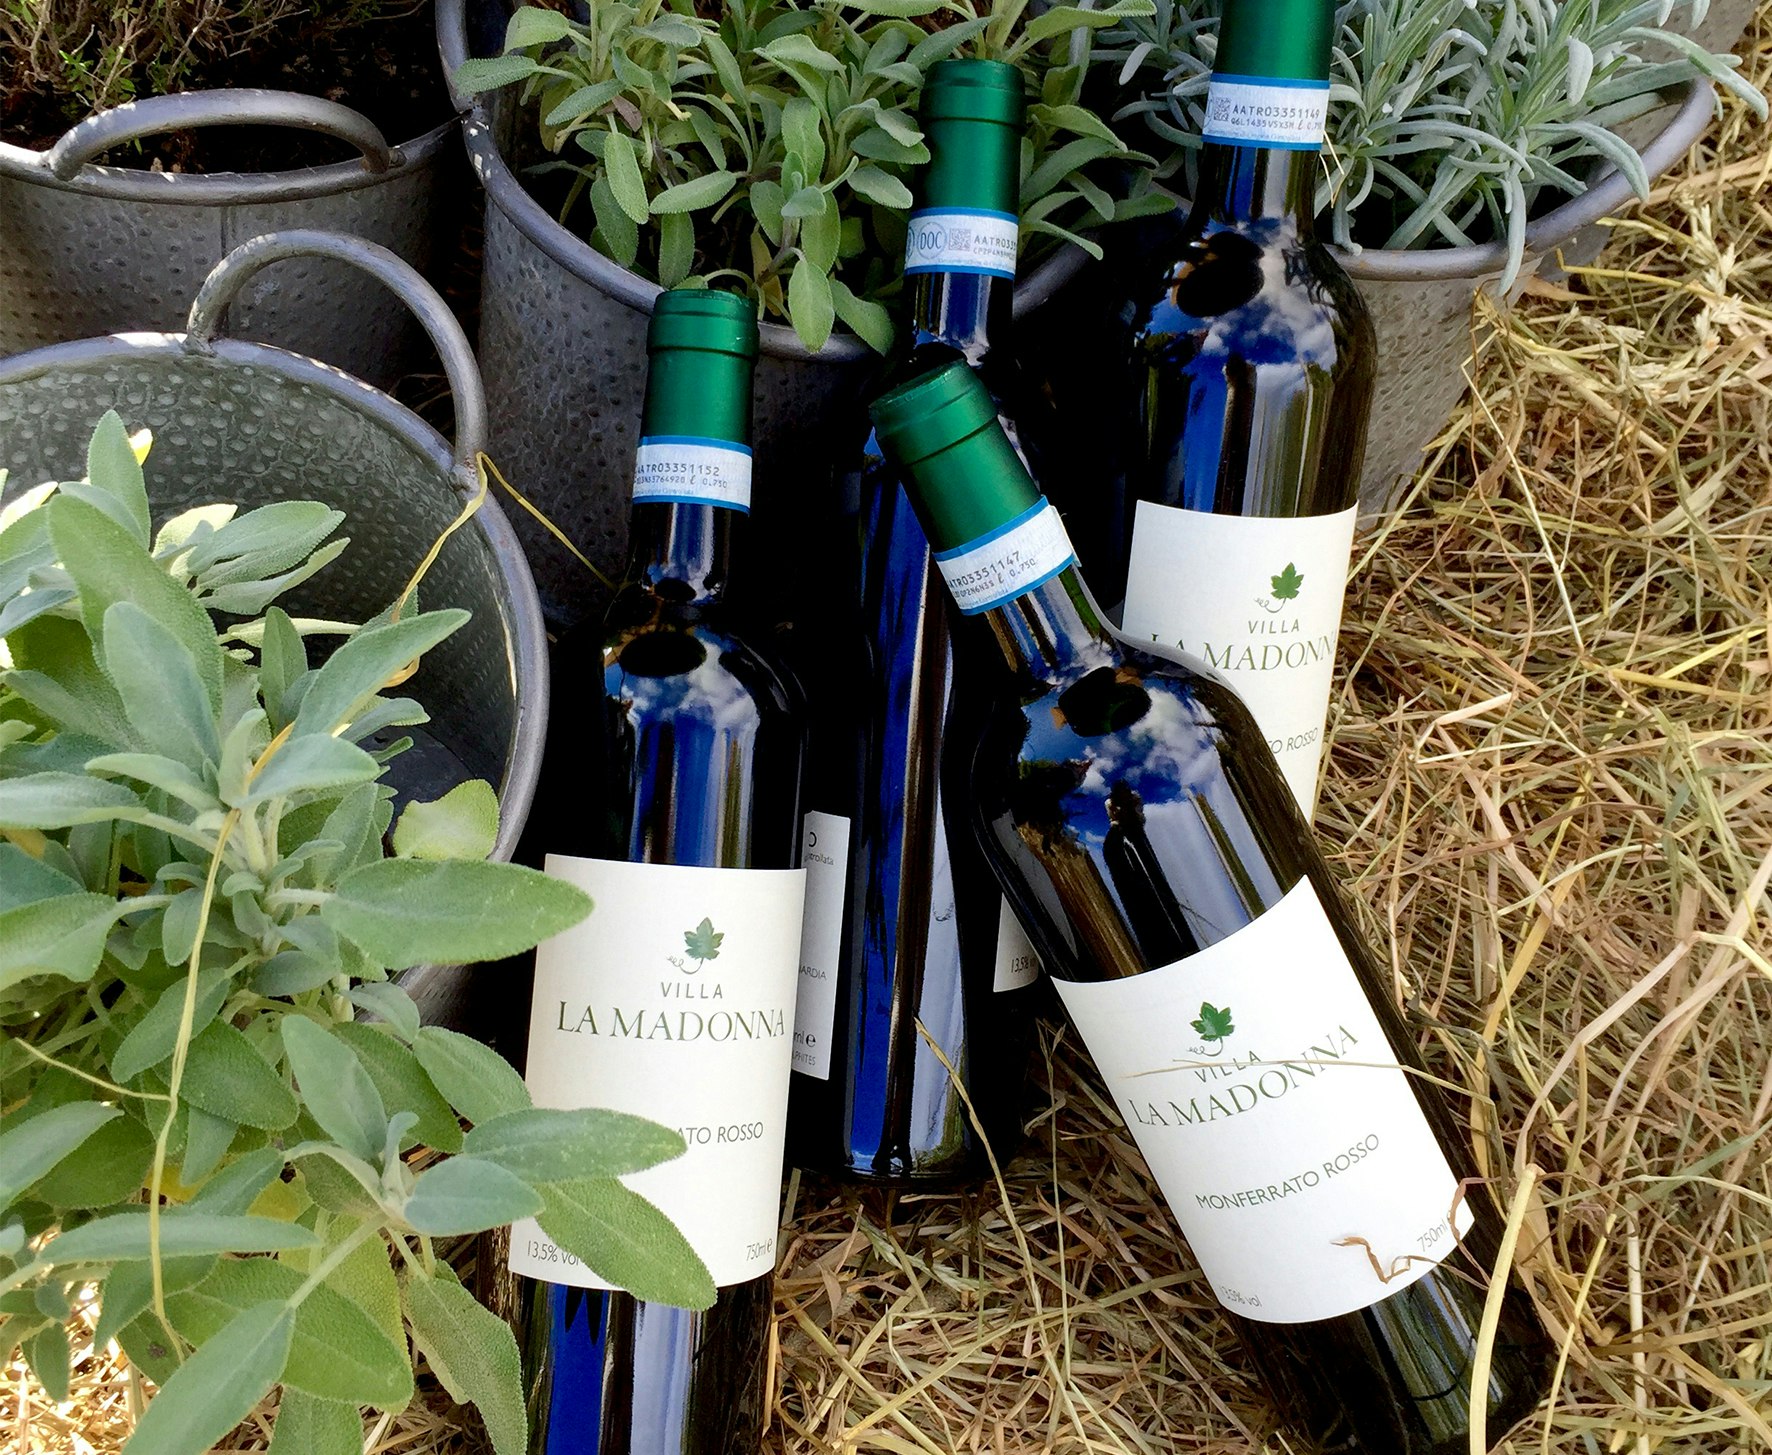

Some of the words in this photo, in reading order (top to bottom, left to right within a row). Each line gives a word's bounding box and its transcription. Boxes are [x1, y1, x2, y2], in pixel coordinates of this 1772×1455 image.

[920, 231, 943, 250] DOC
[1248, 618, 1300, 635] VILLA
[1286, 726, 1319, 752] ROSSO
[660, 981, 724, 1000] VILLA
[556, 1000, 600, 1036] LA
[609, 1006, 786, 1042] MADONNA
[1128, 1098, 1171, 1127] LA
[1167, 1024, 1359, 1127] MADONNA
[1194, 1050, 1262, 1084] VILLA
[717, 1121, 764, 1143] ROSSO
[1194, 1170, 1321, 1210] MONFERRATO
[1322, 1133, 1380, 1179] ROSSO
[1415, 1218, 1449, 1253] 750ml
[527, 1240, 559, 1263] 13,5%
